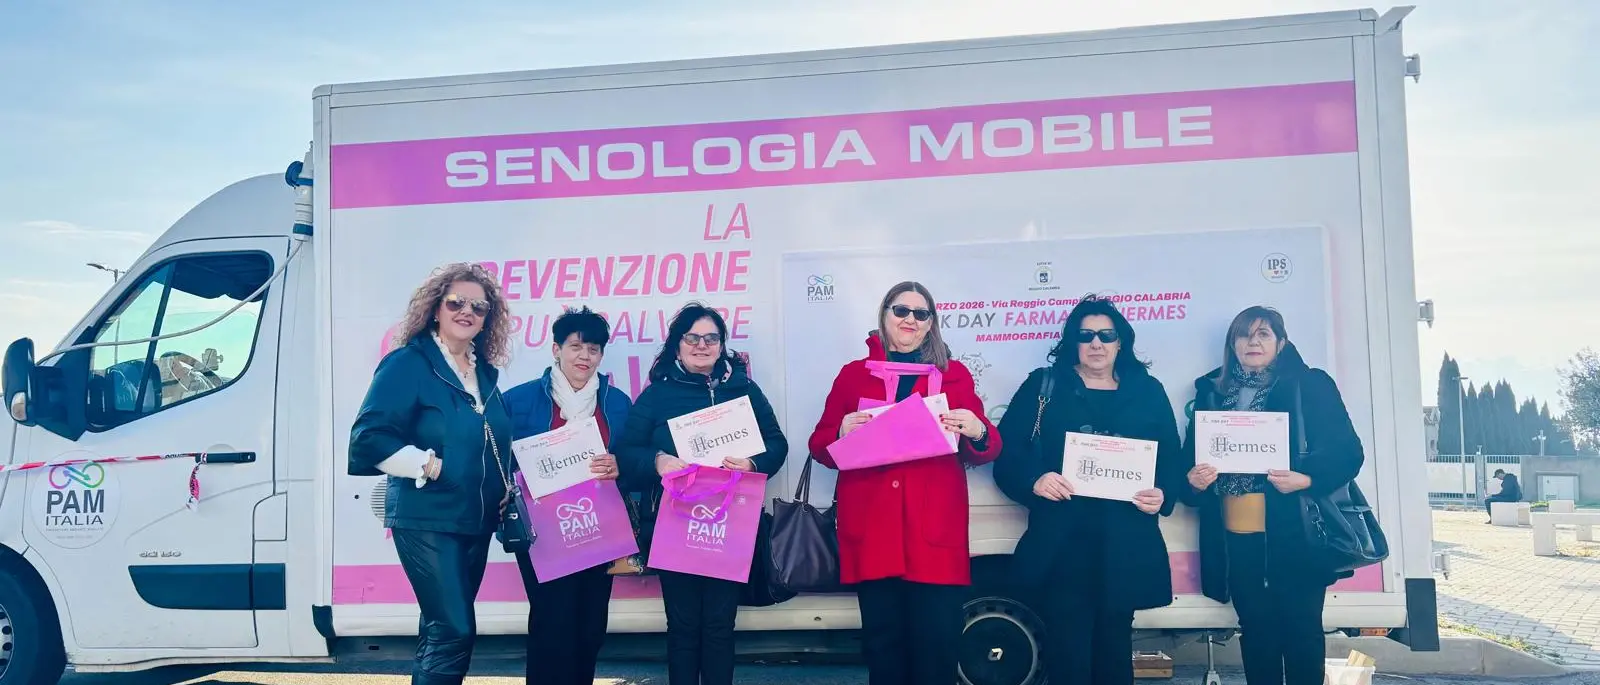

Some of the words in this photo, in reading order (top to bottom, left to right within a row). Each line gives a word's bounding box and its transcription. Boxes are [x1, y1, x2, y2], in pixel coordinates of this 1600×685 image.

[445, 129, 877, 188] SENOLOGIA
[909, 105, 1213, 163] MOBILE
[703, 202, 751, 241] LA
[1267, 258, 1287, 270] IPS
[807, 285, 834, 296] PAM
[936, 302, 957, 310] RZO
[959, 301, 985, 310] 2026
[991, 300, 1008, 308] Via
[1010, 299, 1045, 308] Reggio
[1134, 291, 1192, 302] CALABRIA
[957, 312, 996, 329] DAY
[1004, 309, 1070, 326] FARMA
[976, 331, 1061, 342] MAMMOGRAFIA
[693, 428, 749, 453] Hermes
[1214, 436, 1277, 453] Hermes
[540, 448, 596, 474] Hermes
[1082, 459, 1142, 481] Hermes
[46, 489, 105, 514] PAM
[45, 515, 104, 526] ITALIA
[560, 511, 599, 535] PAM
[687, 520, 726, 538] PAM
[563, 525, 601, 542] ITALIA
[686, 533, 724, 545] ITALIA
